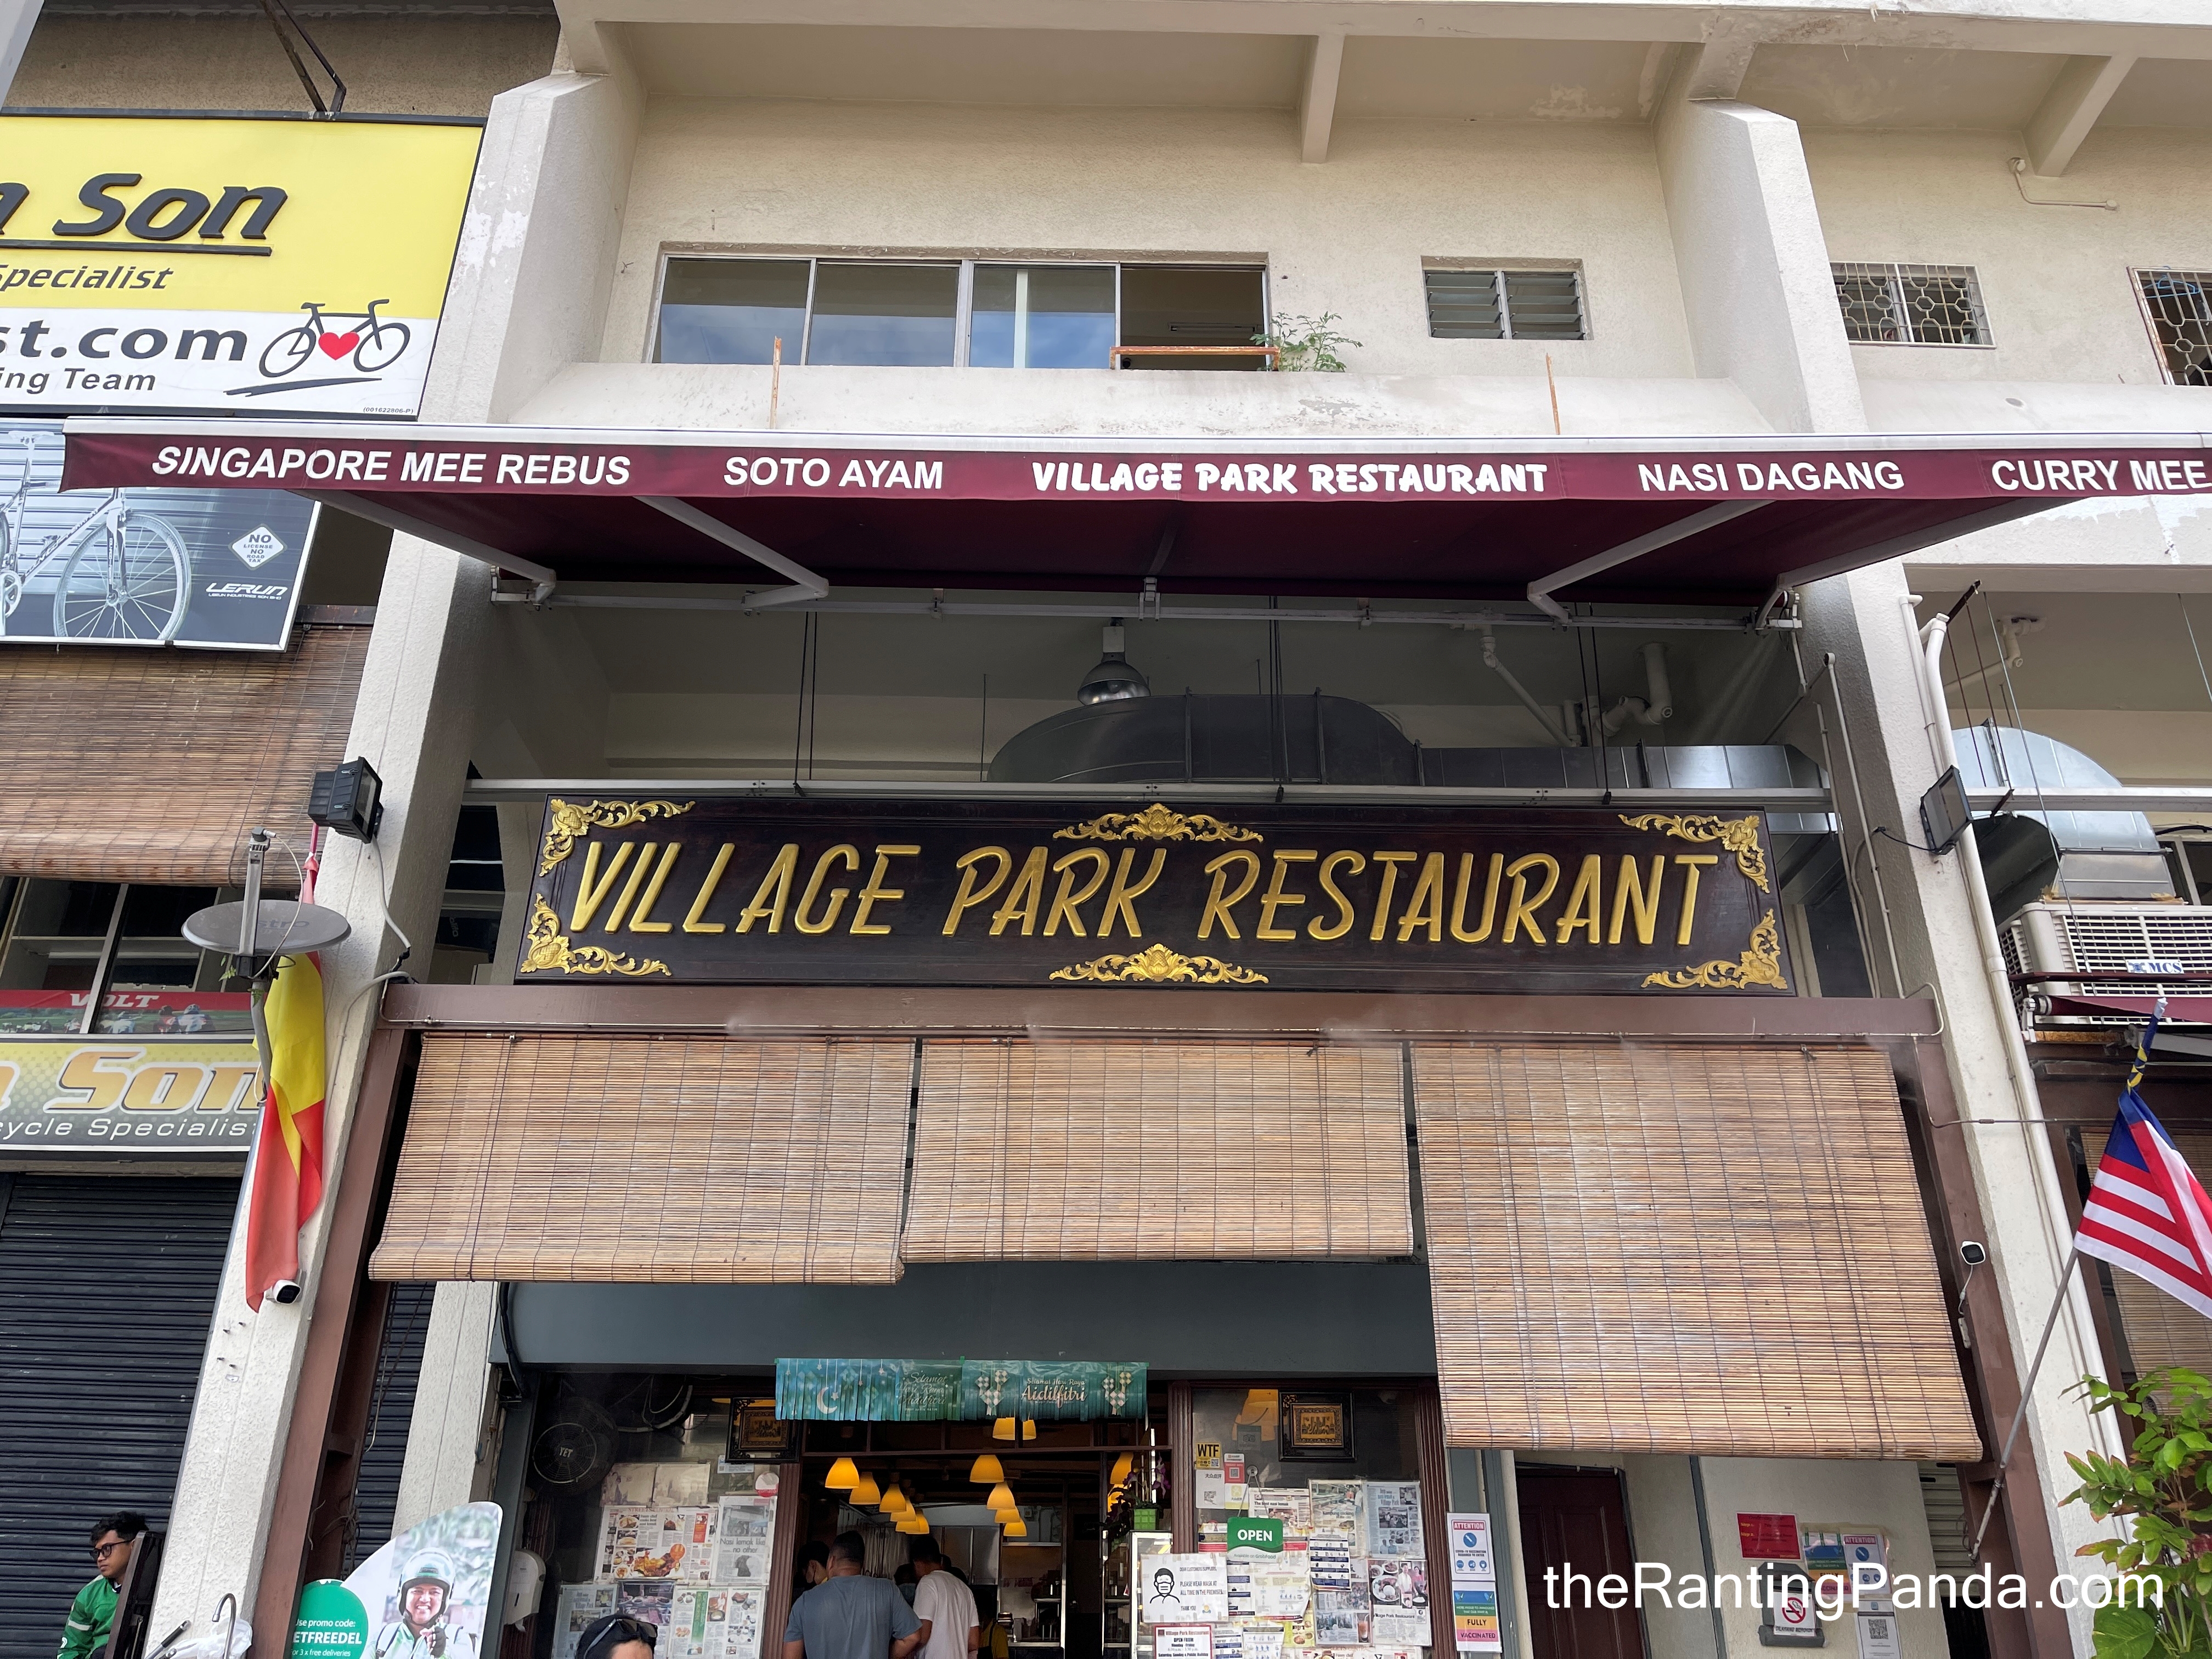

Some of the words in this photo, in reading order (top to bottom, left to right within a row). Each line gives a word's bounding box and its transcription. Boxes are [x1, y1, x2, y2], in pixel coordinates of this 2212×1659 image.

[52, 173, 287, 240] Son
[64, 368, 156, 391] Team
[152, 446, 392, 481] SINGAPORE
[400, 452, 487, 483] MEE
[495, 453, 631, 486] REBUS
[724, 456, 831, 487] SOTO
[838, 459, 943, 489] AYAM
[1032, 462, 1182, 492] VILLAGE
[1195, 464, 1297, 494] PARK
[1308, 464, 1548, 495] RESTAURANT
[1638, 462, 1729, 492] NASI
[1737, 462, 1904, 491] DAGANG
[1991, 460, 2119, 491] CURRY
[2129, 460, 2212, 490] MEE
[249, 534, 272, 543] NO
[206, 583, 287, 595] LERUN
[570, 840, 921, 935] VILLAGE
[942, 845, 1167, 938] PARK
[1197, 848, 1719, 946] RESTAURANT
[2147, 962, 2182, 973] MCS
[43, 1047, 262, 1114] Son
[0, 1118, 72, 1139] ycle
[88, 1118, 257, 1140] Specialis
[1021, 1384, 1087, 1409] Aidilfitri
[1197, 1443, 1220, 1457] WTF
[1238, 1530, 1273, 1542] OPEN
[335, 1619, 356, 1627] code:
